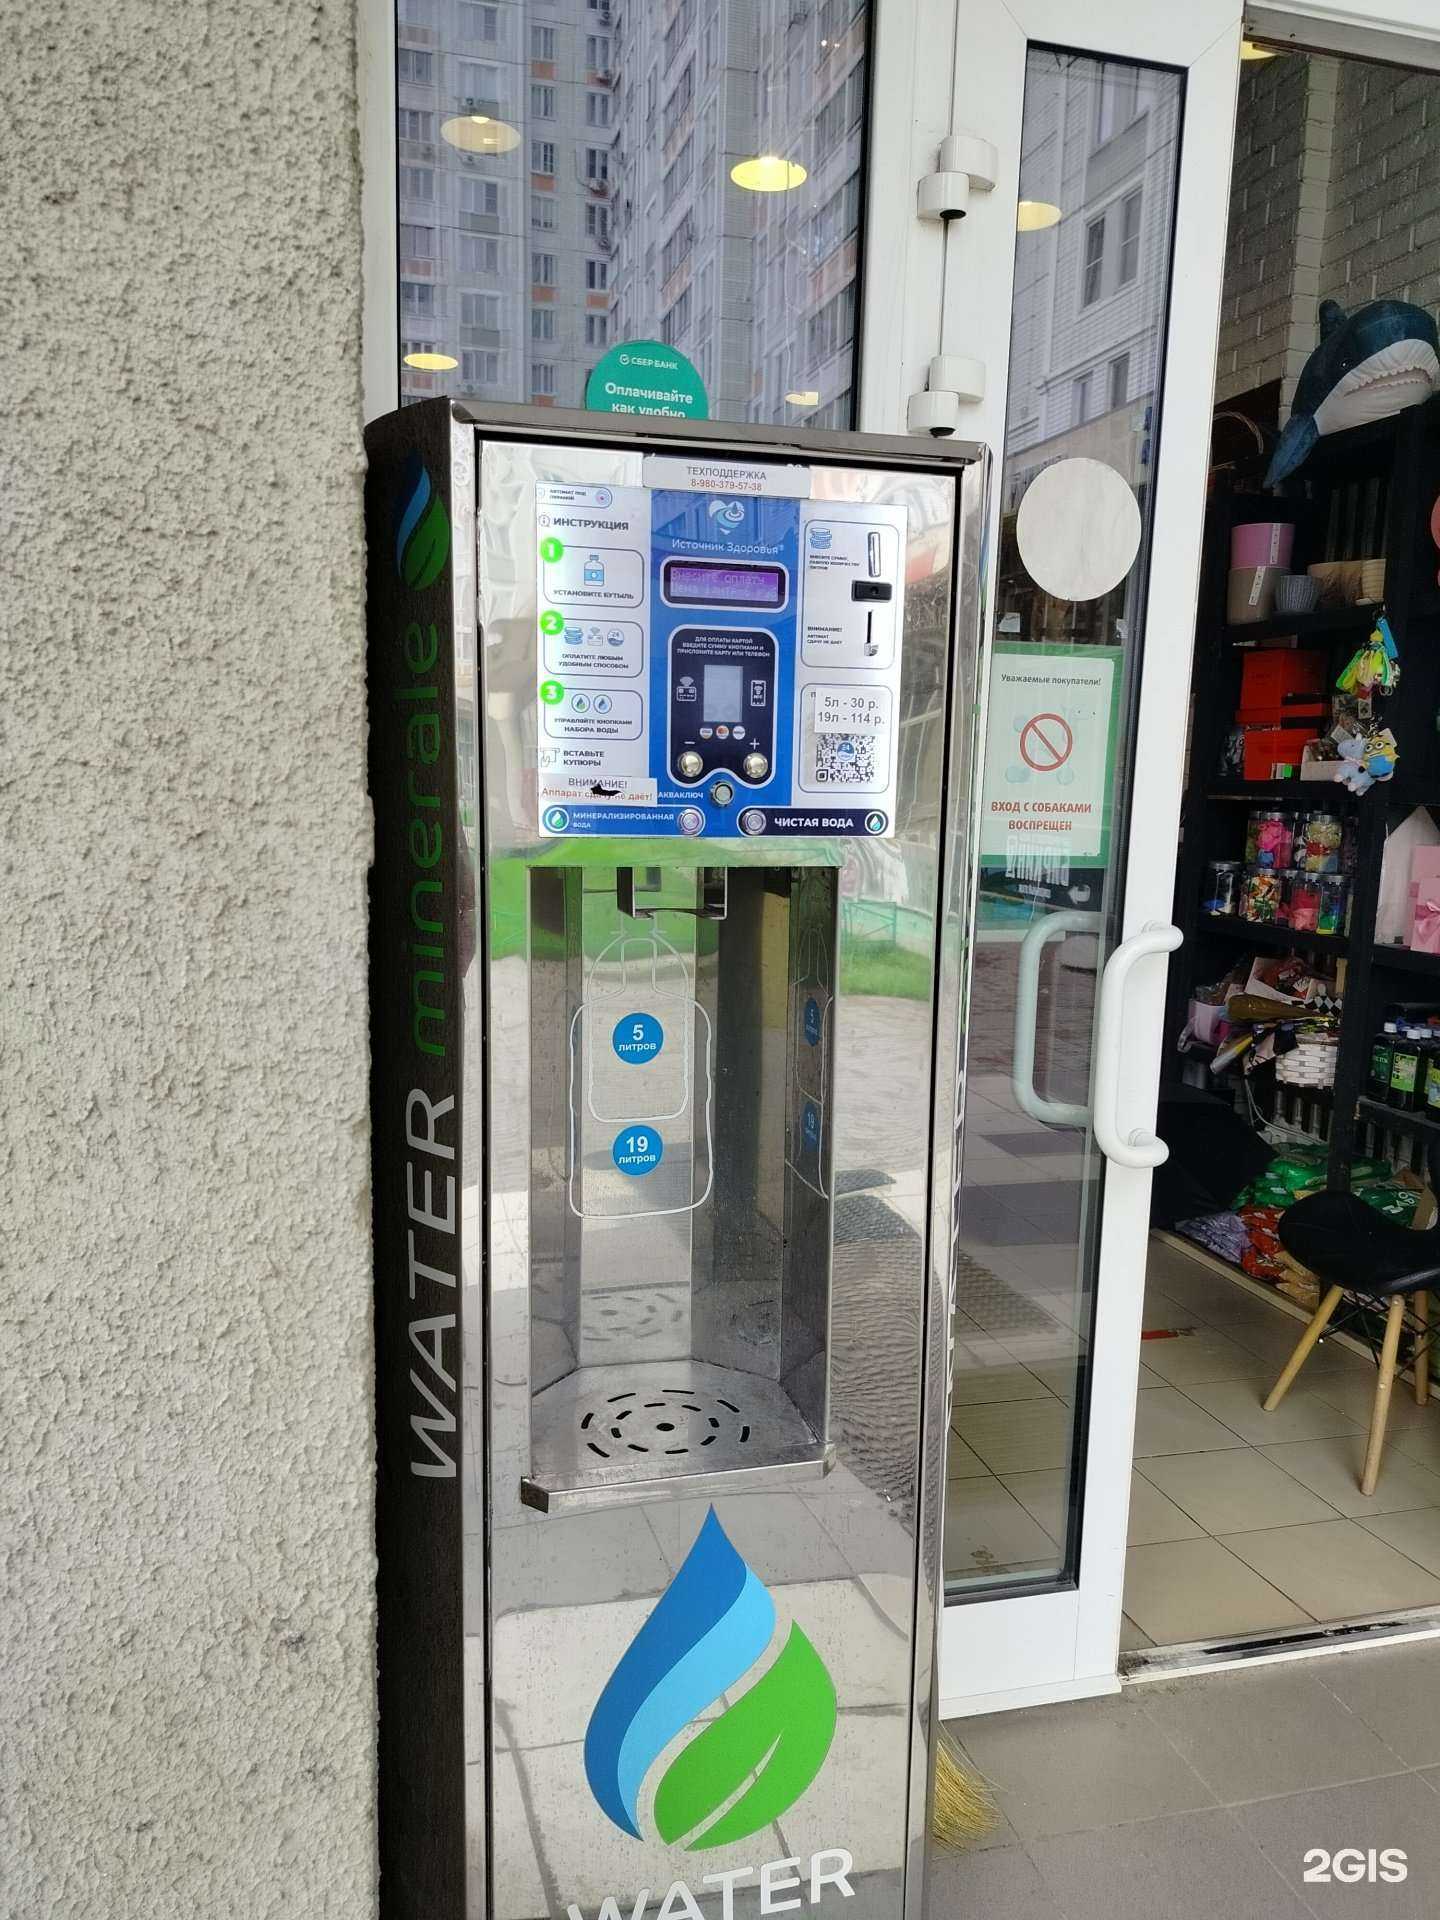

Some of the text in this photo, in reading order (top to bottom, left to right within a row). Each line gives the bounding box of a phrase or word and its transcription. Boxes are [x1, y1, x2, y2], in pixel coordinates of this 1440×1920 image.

[605, 382, 693, 404] Оплачивайте
[612, 403, 635, 414] как
[687, 466, 767, 480] ТЕХПОДДЕРЖКА
[691, 479, 762, 491] 8-980-379-57-38
[553, 518, 629, 531] ИНСТРУКЦИЯ
[672, 538, 725, 552] Источник
[553, 589, 634, 600] УСТАНОВИТЕ БУТЫЛЬ
[545, 616, 557, 630] 2
[562, 653, 596, 661] ОПЛАТИТЕ
[1001, 673, 1101, 687] Уважаемые покупатели!
[545, 685, 557, 700] 3
[824, 697, 839, 708] 5л
[850, 697, 864, 709] 30
[868, 700, 879, 711] р.
[818, 711, 839, 723] 19л
[851, 712, 871, 724] 114
[564, 726, 619, 735] НАБОРА ВОДЫ
[563, 750, 604, 758] ВСТАВЬТЕ
[563, 758, 602, 767] КУПЮРЫ
[568, 777, 628, 789] ВНИМАНИЕ!
[542, 787, 582, 799] Аппарат
[658, 791, 704, 800] АКВАКЛЮЧ
[991, 801, 1092, 814] ВХОД С СОБАКАМИ
[573, 811, 675, 822] МИНЕРАЛИЗИРОВАННАЯ
[573, 821, 592, 829] ВОДА
[774, 817, 854, 829] ЧИСТАЯ ВОДА
[1008, 819, 1072, 832] ВОСПРЕЩЕН
[393, 622, 446, 1057] minerale
[632, 1024, 644, 1041] 5
[618, 1041, 657, 1053] литров
[626, 1136, 649, 1153] 19
[618, 1154, 657, 1165] литров
[405, 1088, 457, 1478] WATER
